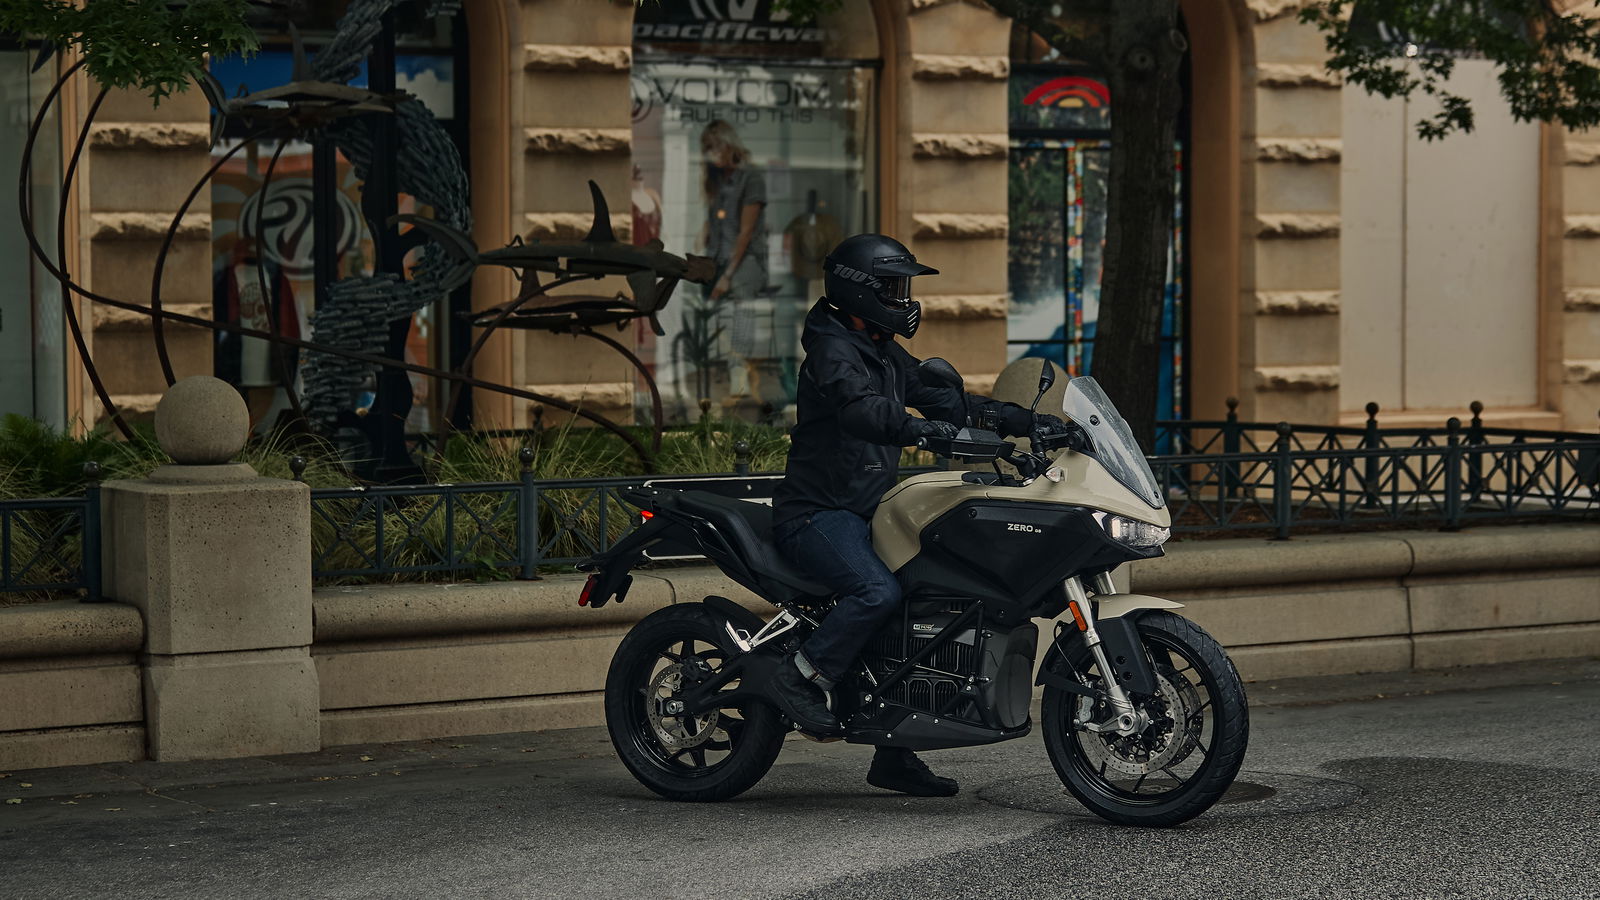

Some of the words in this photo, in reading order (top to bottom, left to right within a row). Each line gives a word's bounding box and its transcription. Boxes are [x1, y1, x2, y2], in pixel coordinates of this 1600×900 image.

[653, 78, 828, 105] VOLCOM
[732, 107, 759, 123] TO
[768, 107, 812, 123] THIS
[832, 263, 882, 288] 100%
[1007, 523, 1034, 532] ZERO
